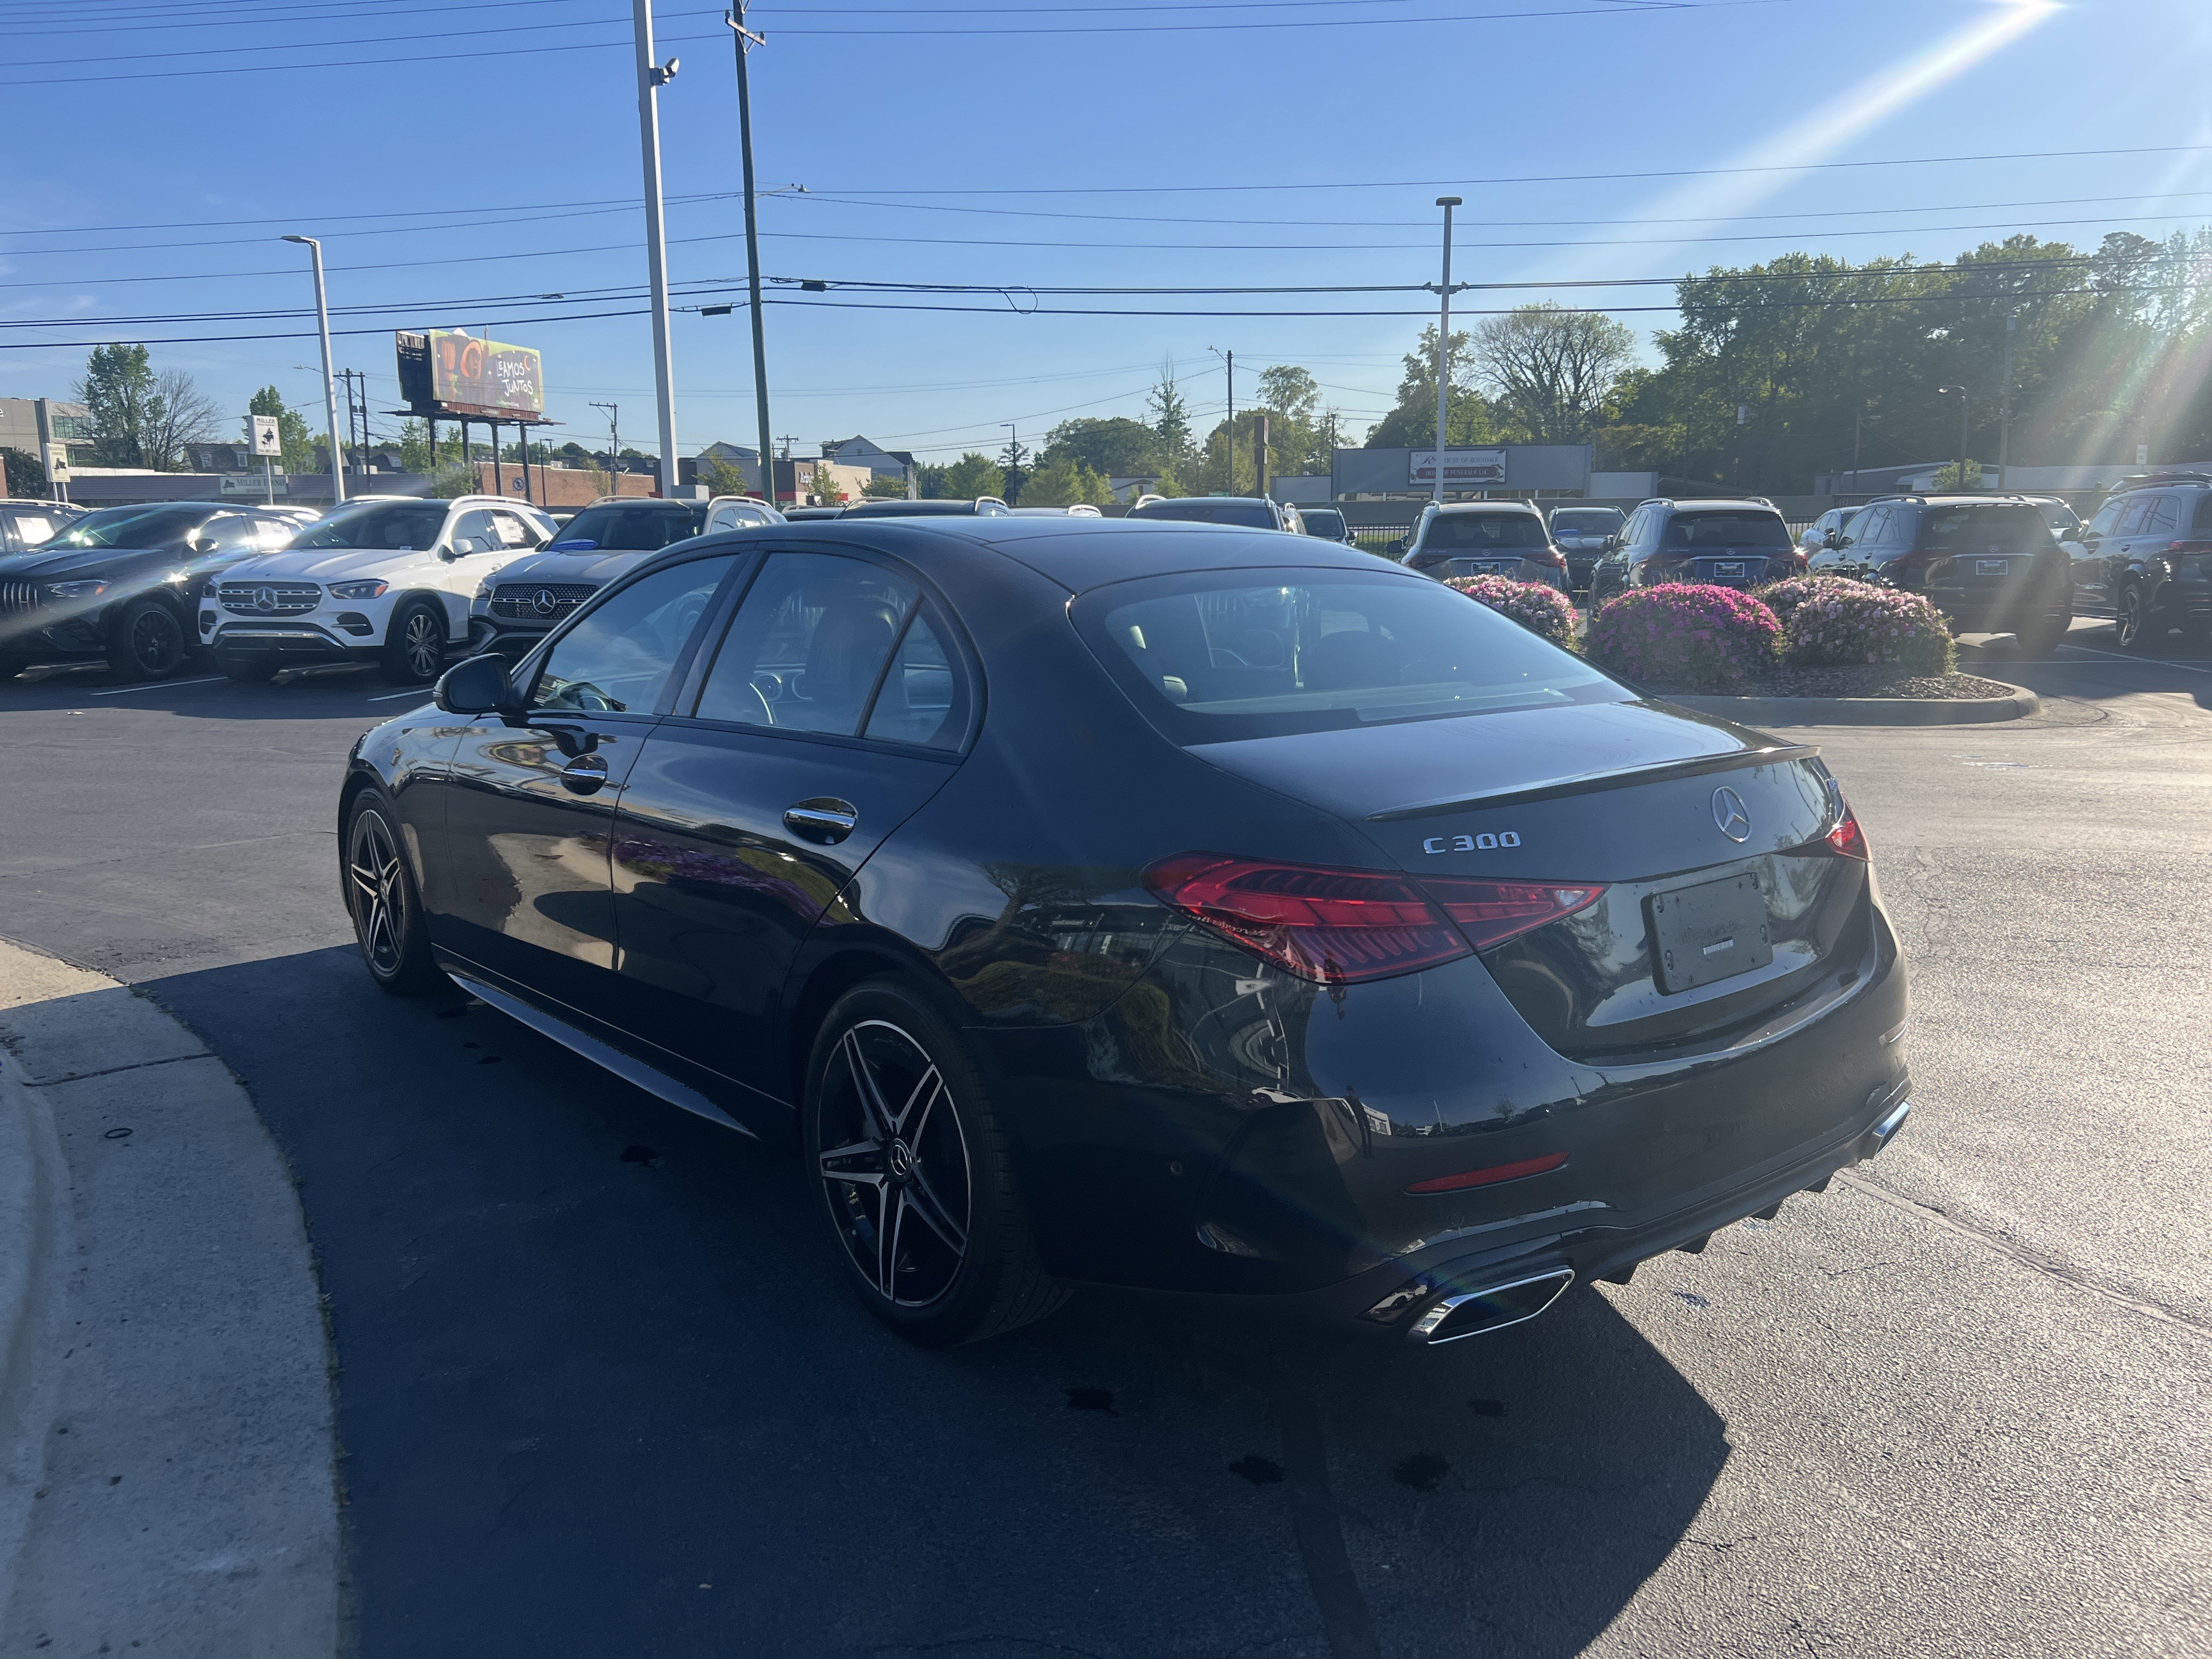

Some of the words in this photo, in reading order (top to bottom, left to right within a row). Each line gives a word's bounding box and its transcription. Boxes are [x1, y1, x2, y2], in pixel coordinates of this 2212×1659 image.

[495, 360, 524, 378] LEAMOS
[1423, 837, 1447, 854] C
[1452, 831, 1521, 852] 300
